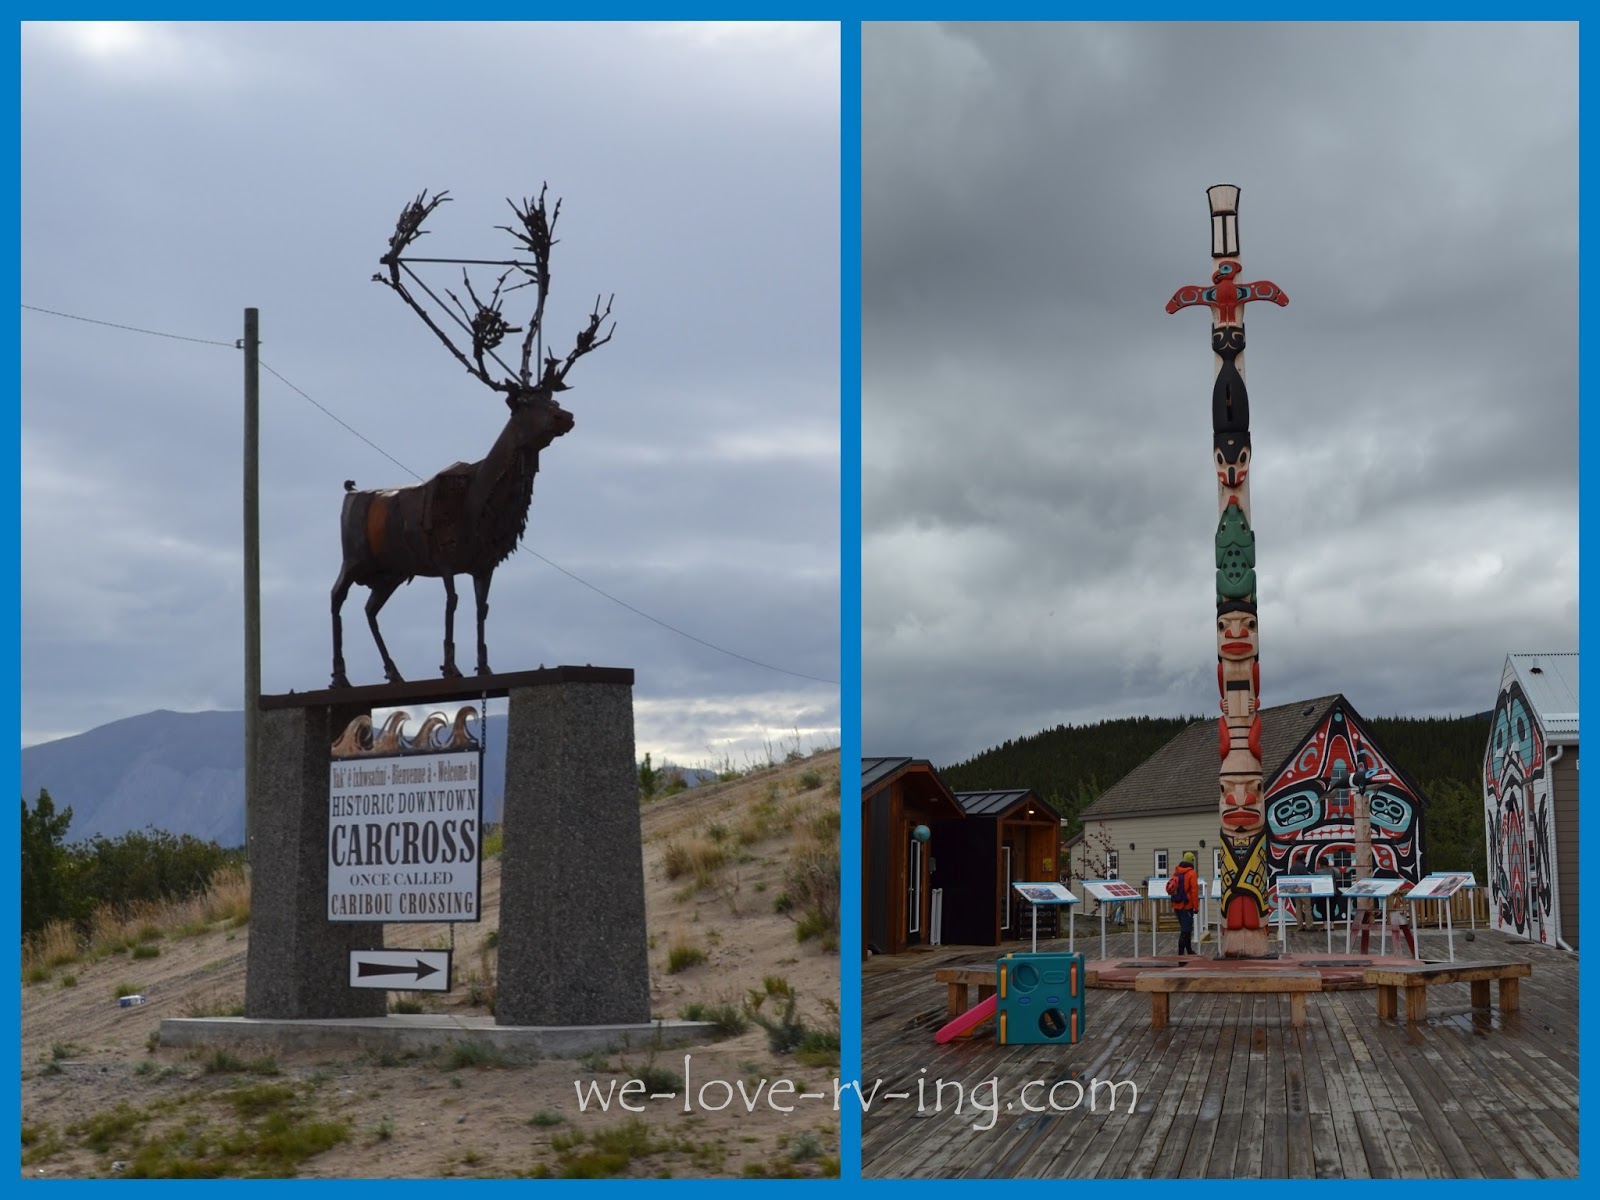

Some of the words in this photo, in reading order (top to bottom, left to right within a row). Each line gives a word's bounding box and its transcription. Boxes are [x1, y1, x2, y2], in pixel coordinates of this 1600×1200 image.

[438, 760, 468, 782] Welcome
[469, 760, 477, 780] to
[332, 793, 395, 817] HISTORIC
[397, 788, 477, 814] DOWNTOWN
[331, 818, 476, 867] CARCROSS
[349, 872, 391, 887] ONCE
[393, 871, 454, 886] CALLED
[331, 893, 393, 915] CARIBOU
[399, 891, 474, 915] CROSSING
